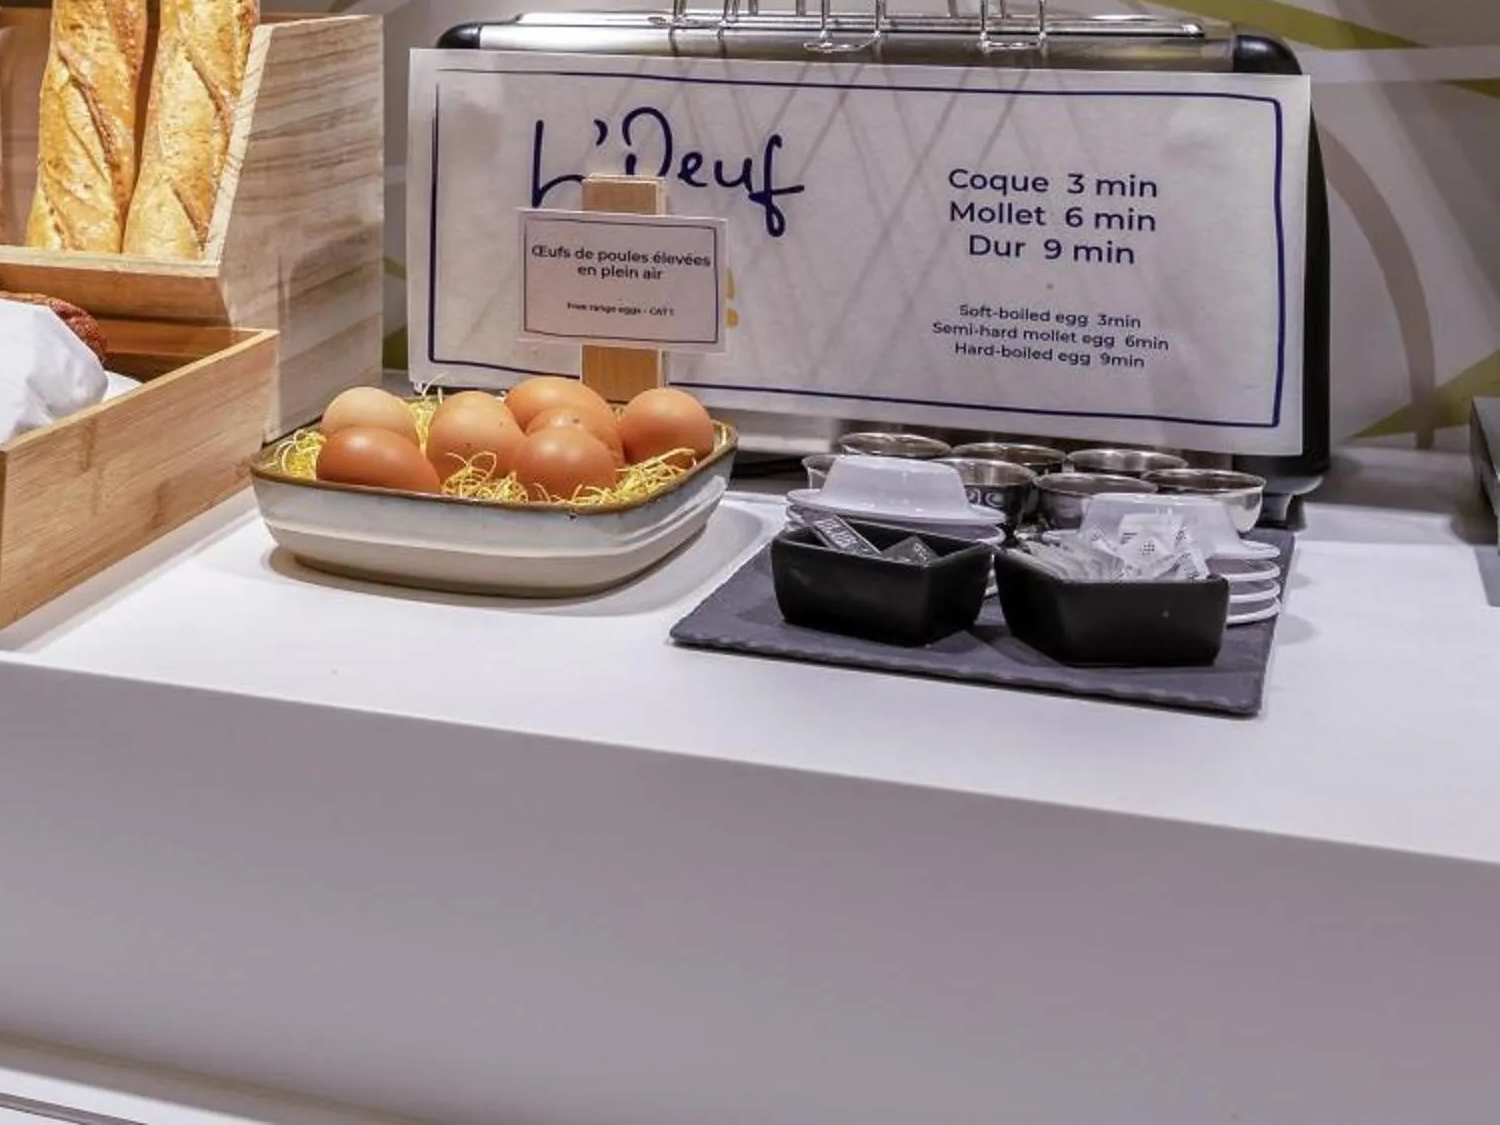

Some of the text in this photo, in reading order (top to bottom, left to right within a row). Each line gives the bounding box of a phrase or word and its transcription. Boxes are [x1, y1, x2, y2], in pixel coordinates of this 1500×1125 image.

[949, 168, 1157, 197] Coque 3 min
[949, 201, 1156, 231] Mollet 6 min
[575, 246, 595, 260] de
[597, 250, 649, 264] poules
[653, 250, 711, 267] élevées
[969, 234, 1134, 264] Dur 9 min
[577, 264, 665, 280] en plein air
[959, 304, 1141, 329] Soft-boiled egg 3min
[932, 321, 1170, 351] Semi-hard mollet egg 6min
[955, 342, 1145, 368] Hard-boiled egg 9min
